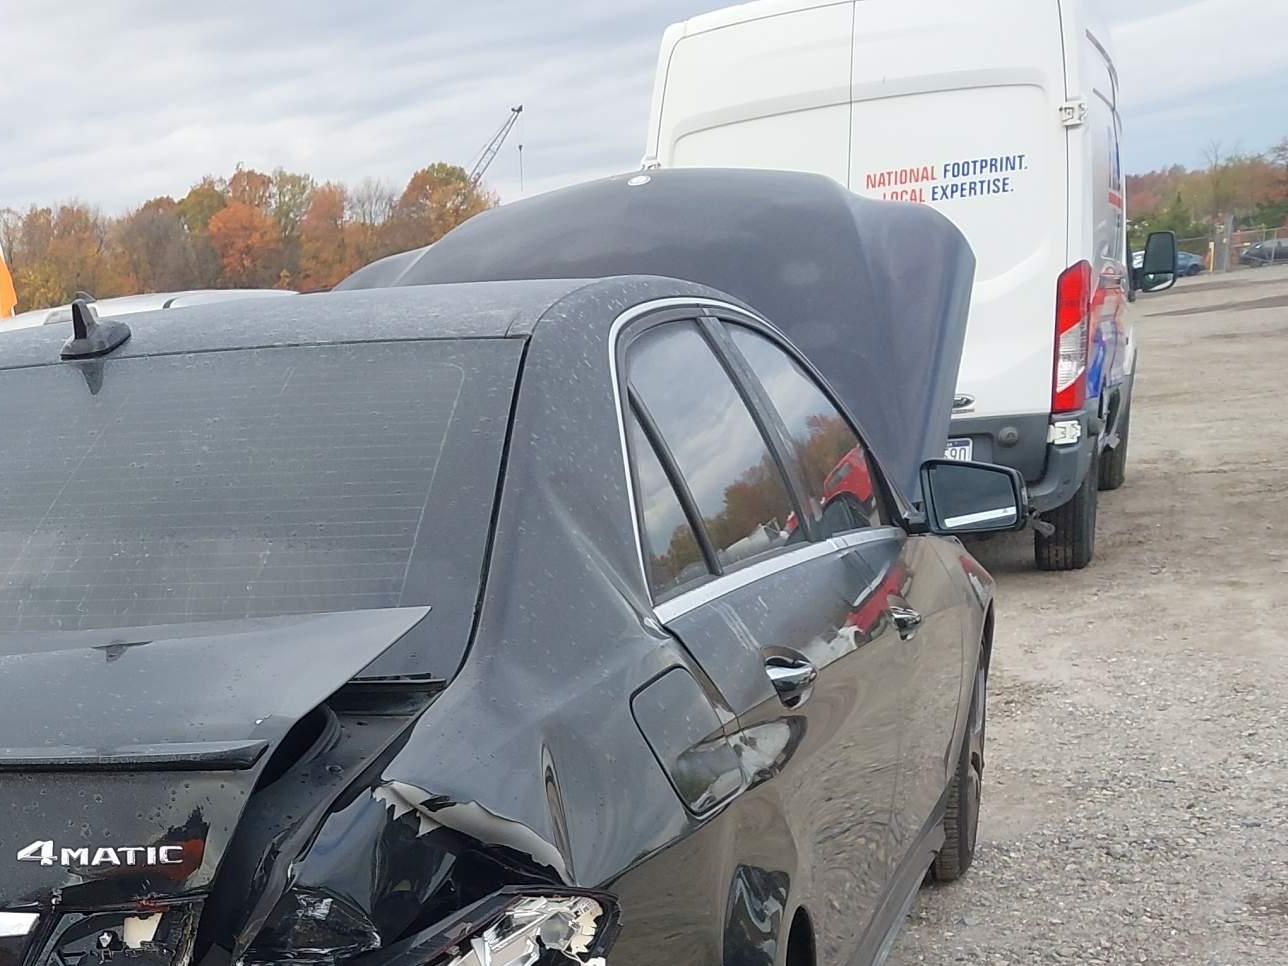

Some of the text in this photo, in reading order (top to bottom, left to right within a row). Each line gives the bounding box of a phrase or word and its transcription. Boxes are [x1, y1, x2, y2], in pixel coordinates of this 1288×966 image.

[866, 154, 1028, 189] NATIONAL FOOTPRINT.
[931, 177, 1014, 201] EXPERTISE.
[16, 839, 184, 866] 4MATIC
